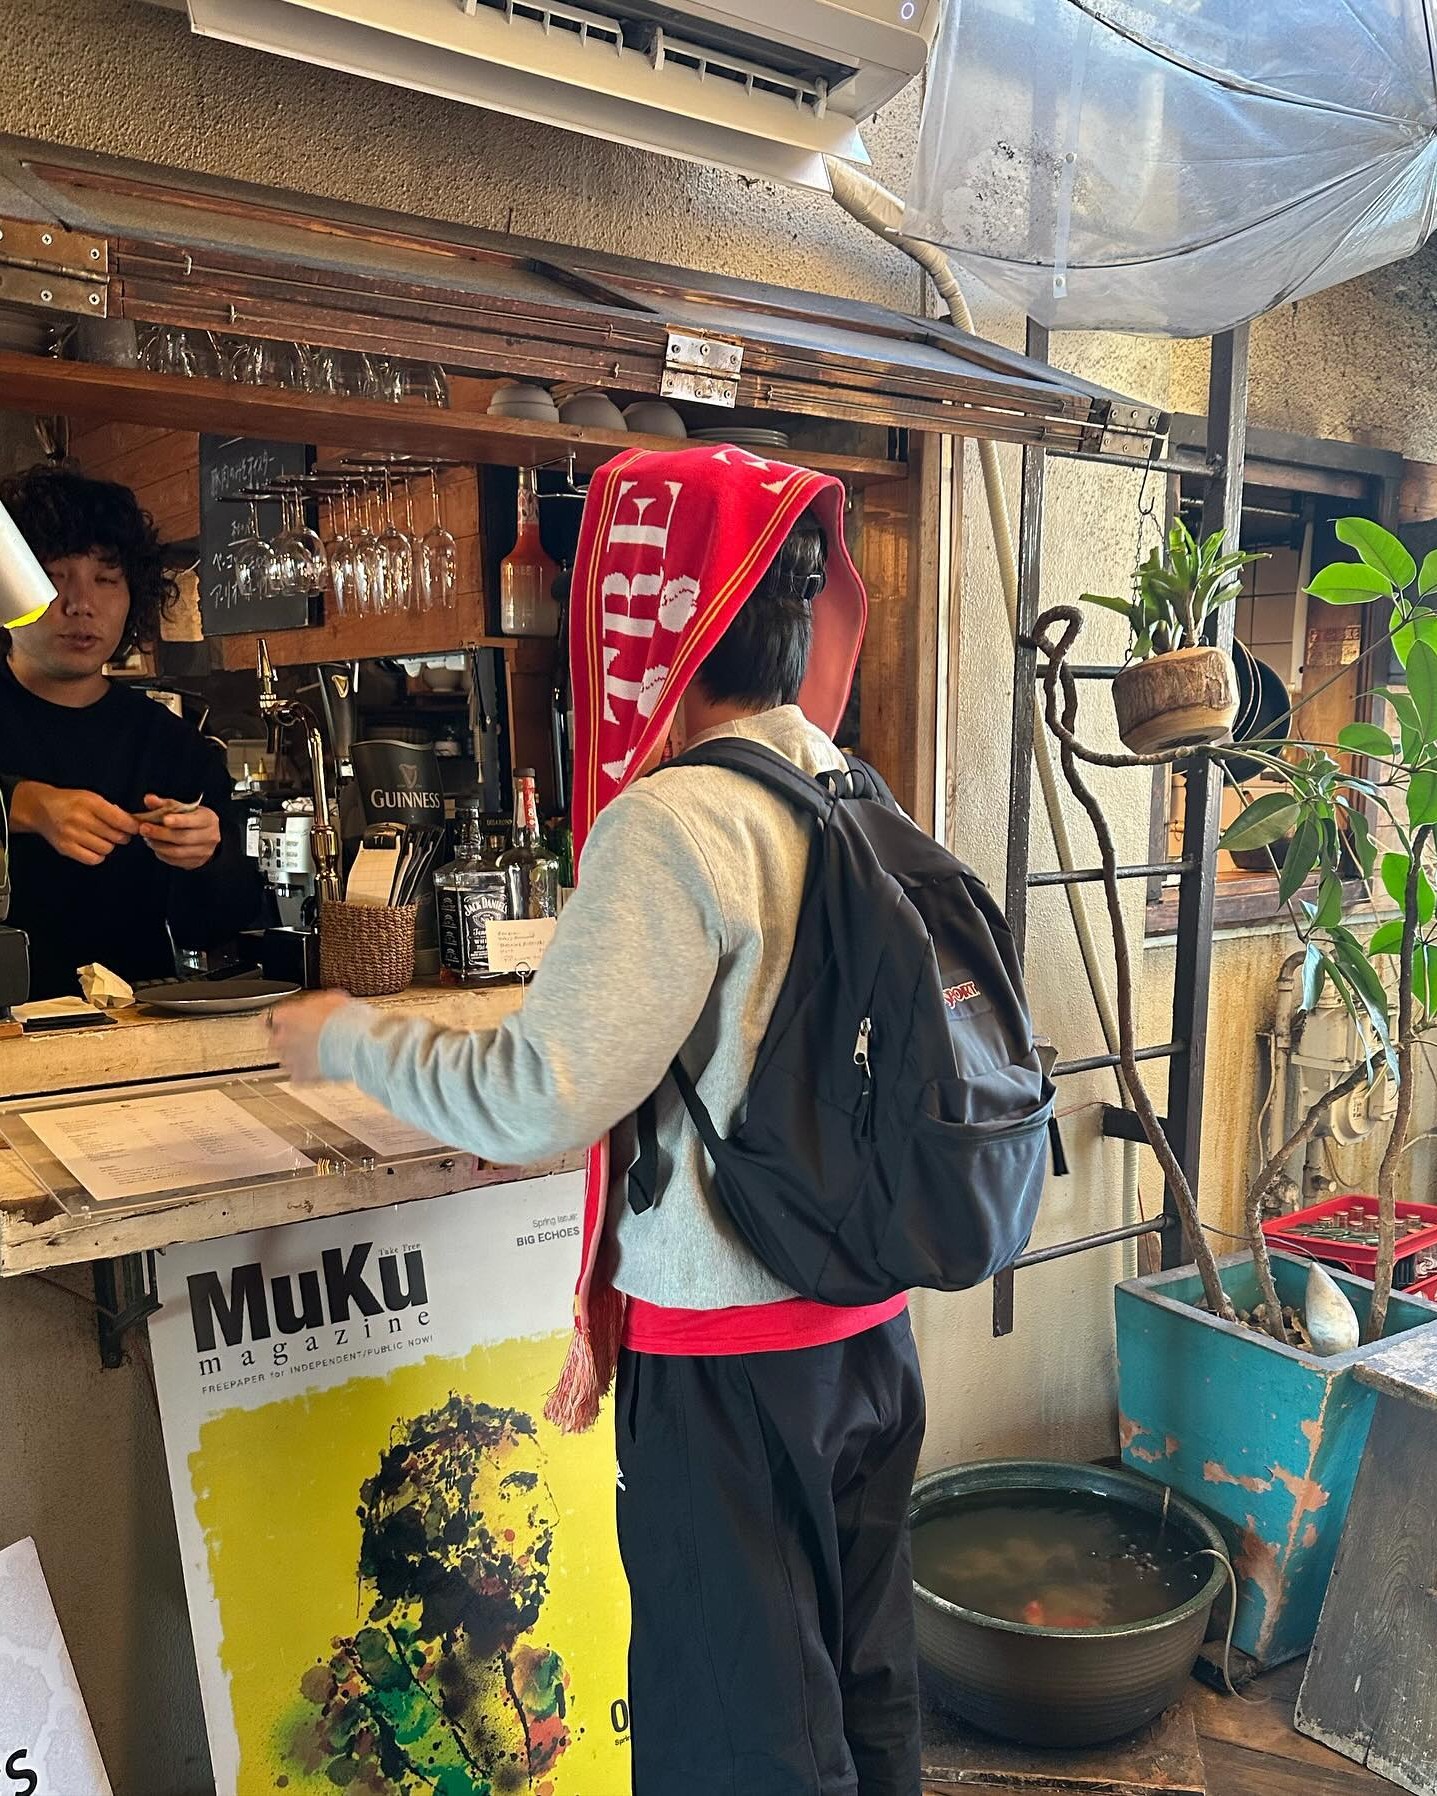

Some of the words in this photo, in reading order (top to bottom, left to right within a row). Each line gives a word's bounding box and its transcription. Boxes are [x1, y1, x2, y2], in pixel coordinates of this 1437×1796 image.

[371, 789, 441, 810] GUINNESS
[532, 1217, 557, 1229] Spring
[516, 1235, 535, 1247] BIG
[538, 1226, 580, 1243] ECHOES
[186, 1241, 429, 1353] MuKu
[199, 1310, 431, 1376] magazine
[201, 1373, 266, 1395] FREEPAPER
[270, 1370, 286, 1379] for
